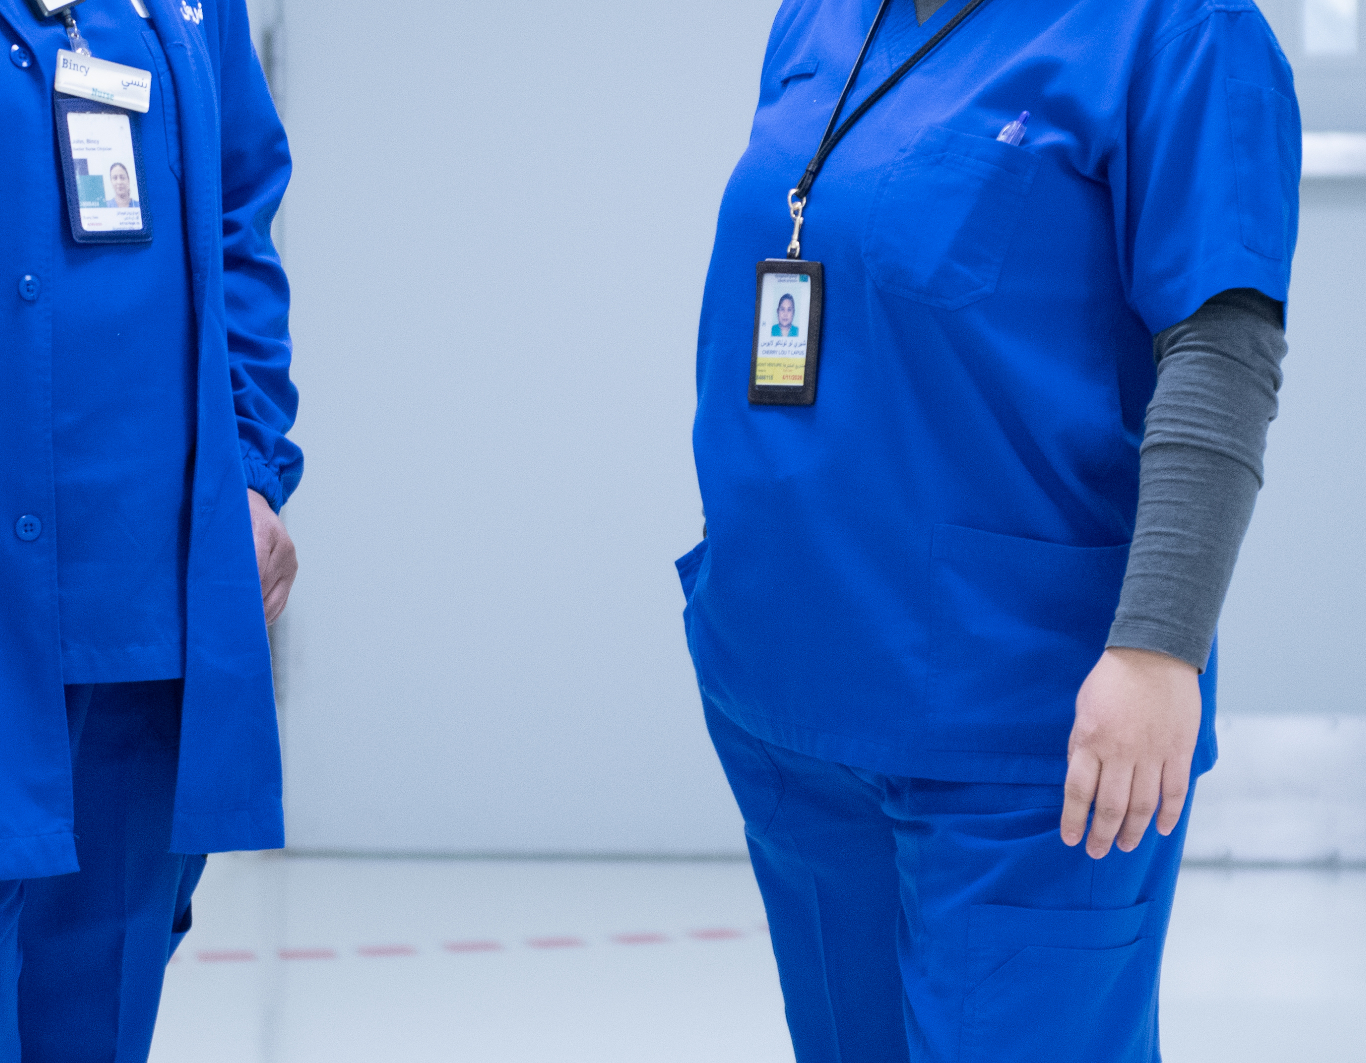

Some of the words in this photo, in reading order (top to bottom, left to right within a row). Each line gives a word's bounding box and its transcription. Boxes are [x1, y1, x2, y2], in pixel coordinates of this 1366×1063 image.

[62, 58, 90, 76] Bincy
[121, 78, 147, 92] بنسي
[91, 87, 114, 101] Nurse
